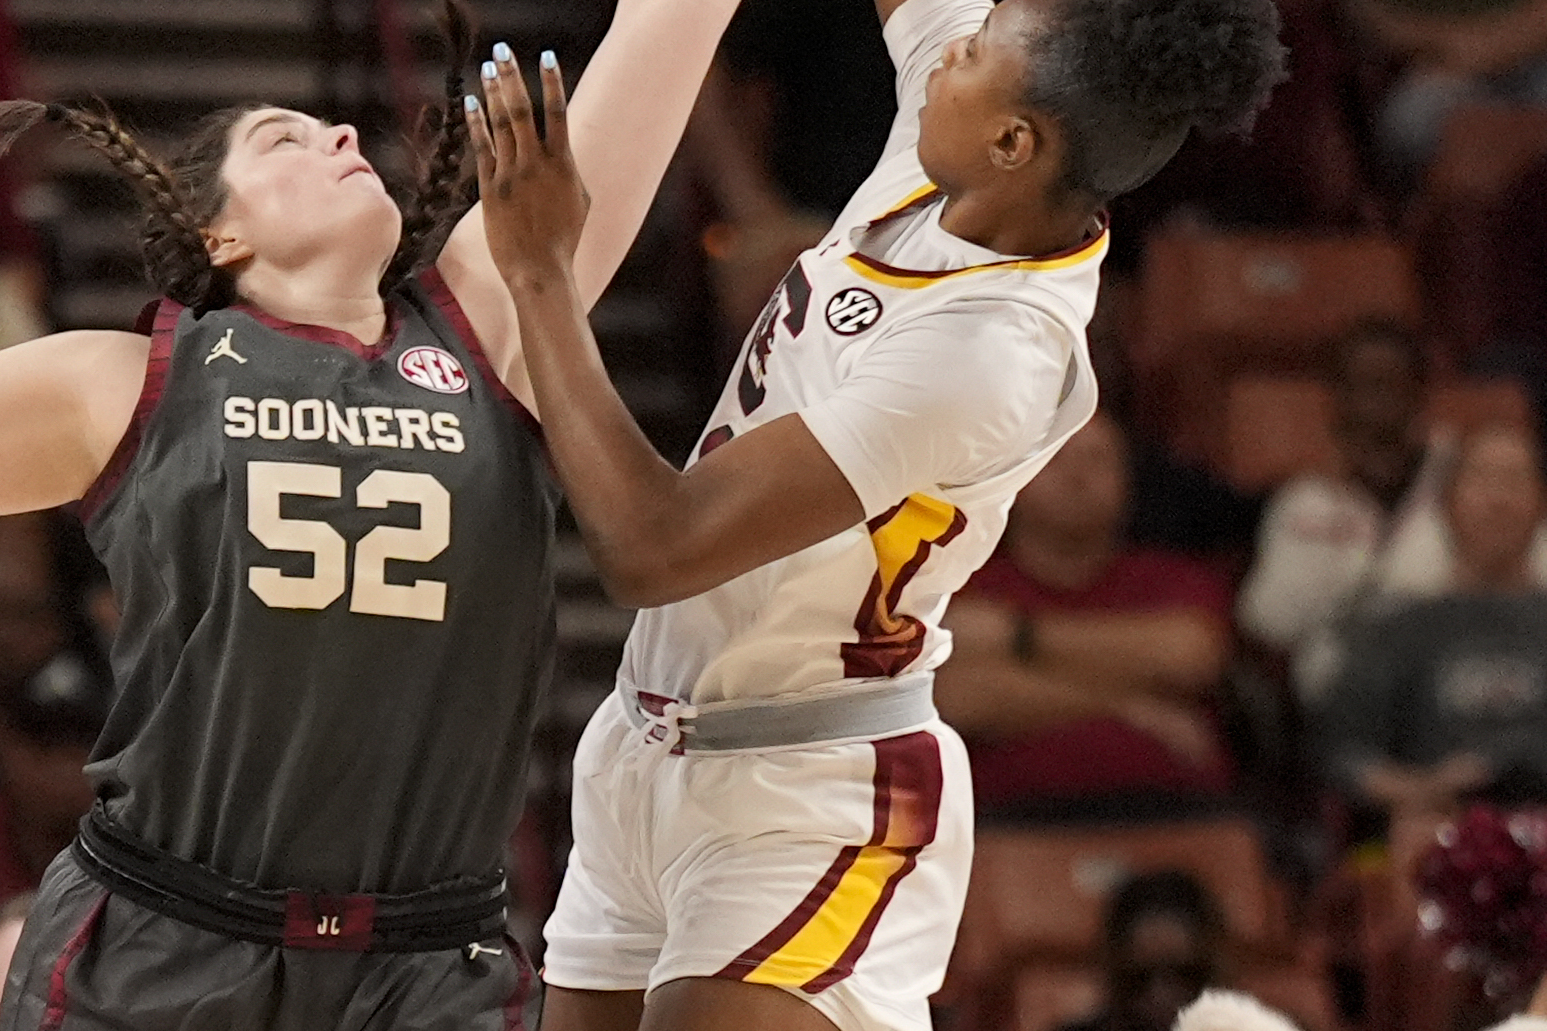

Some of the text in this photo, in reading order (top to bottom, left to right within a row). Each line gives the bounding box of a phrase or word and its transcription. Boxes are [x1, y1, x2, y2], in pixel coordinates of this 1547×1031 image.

[827, 289, 881, 333] SEC
[401, 347, 468, 392] SEC
[223, 395, 466, 454] SOONERS
[246, 460, 452, 622] 52
